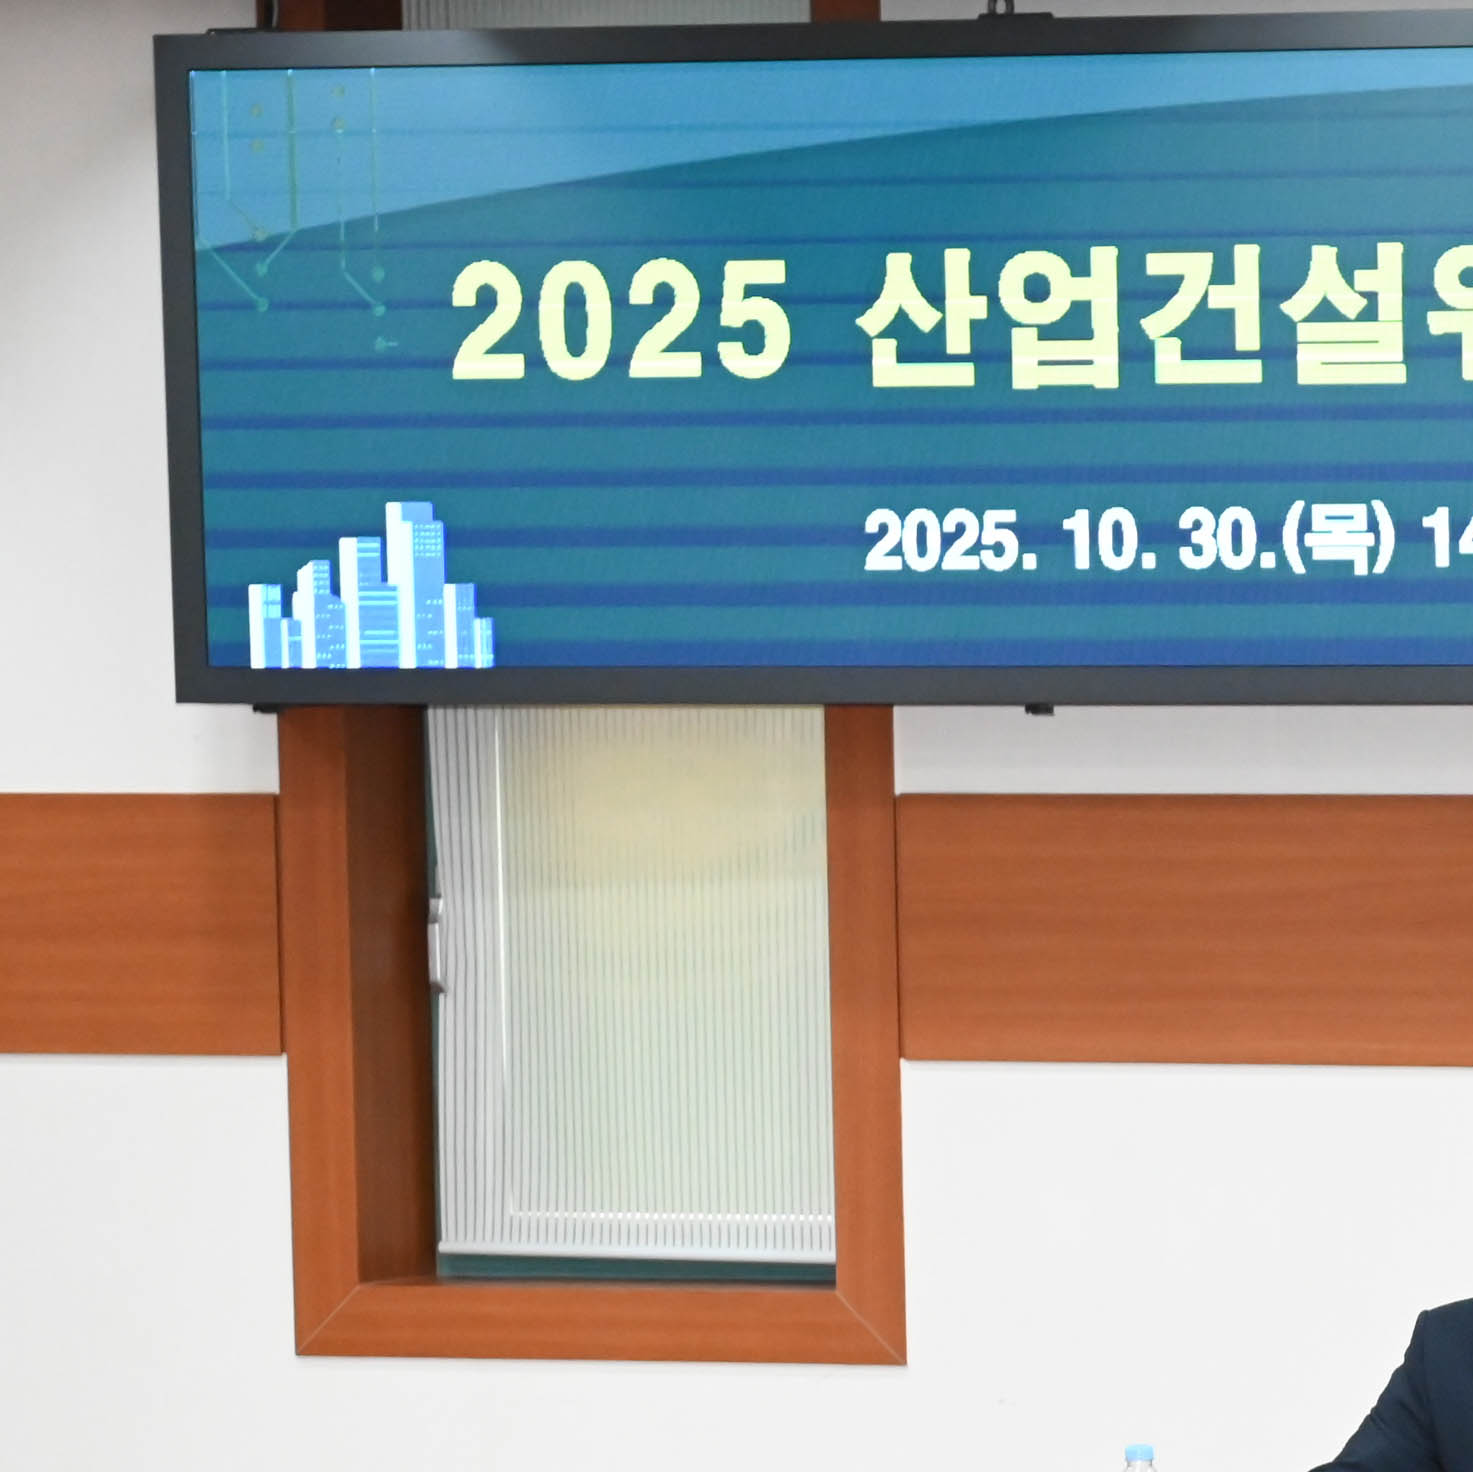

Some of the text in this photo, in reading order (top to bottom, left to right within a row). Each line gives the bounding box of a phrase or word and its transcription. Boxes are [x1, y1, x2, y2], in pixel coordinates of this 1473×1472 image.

[451, 257, 792, 381] 2025
[863, 507, 1039, 572] 2025.
[1062, 506, 1158, 571] 10.
[1178, 499, 1396, 577] 30.(목)
